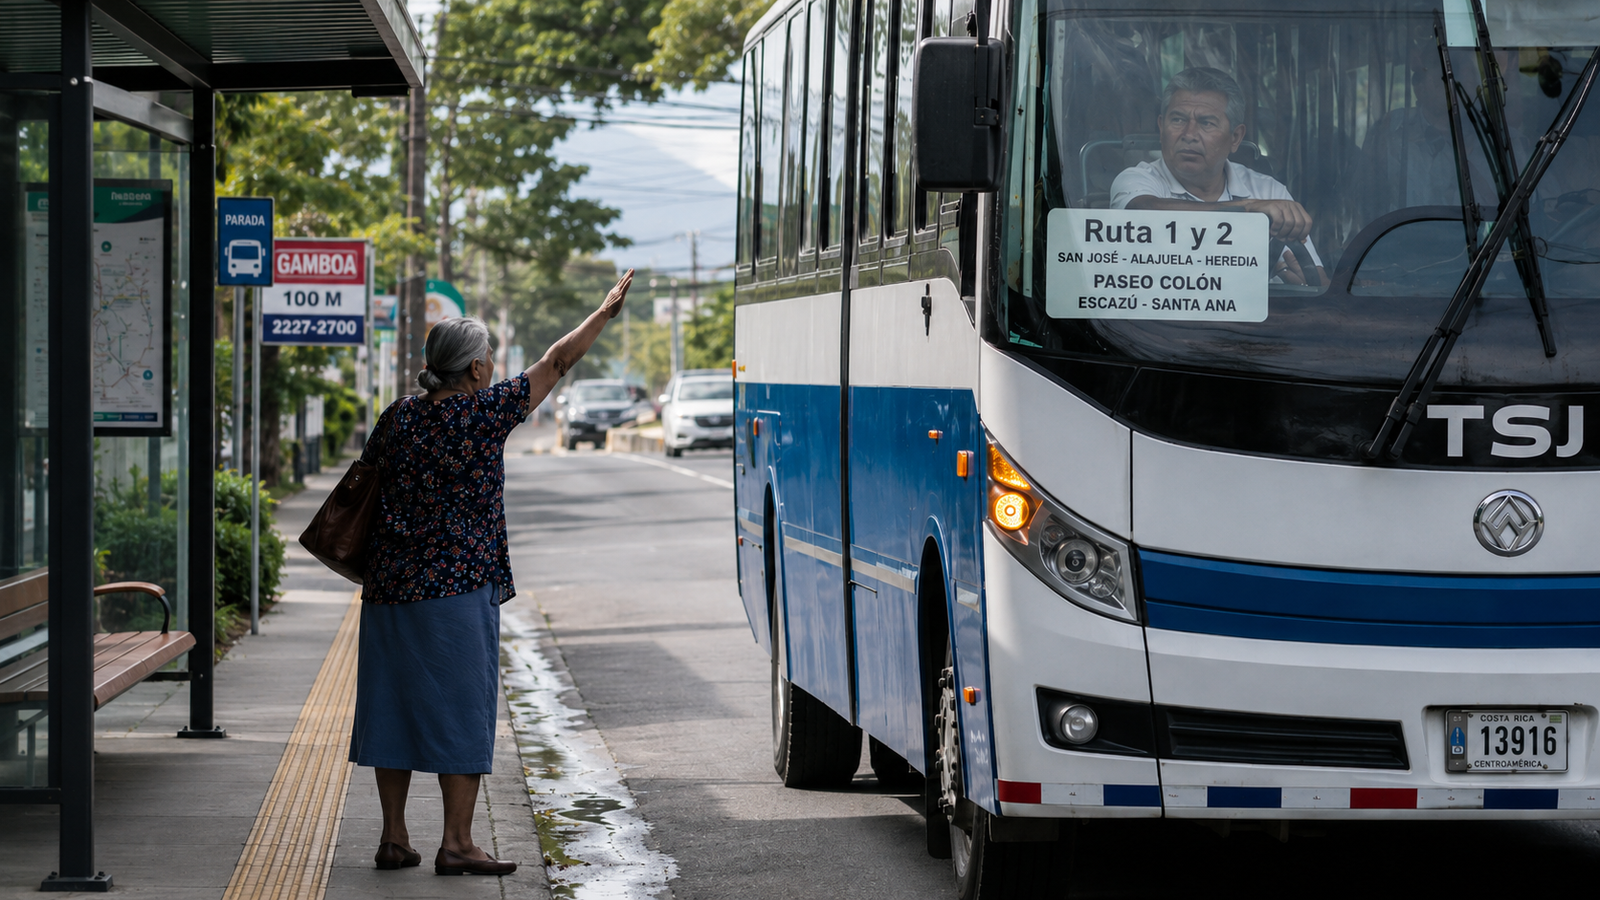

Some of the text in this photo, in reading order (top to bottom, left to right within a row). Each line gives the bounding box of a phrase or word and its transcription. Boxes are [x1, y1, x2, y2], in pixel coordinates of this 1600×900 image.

[225, 214, 265, 226] PARADA
[1085, 218, 1233, 251] Ruta 1 y 2
[277, 253, 357, 275] GAMBOA
[1058, 252, 1083, 263] SAN
[1087, 250, 1119, 264] JOSÉ
[1130, 253, 1193, 266] ALAJUELA
[1205, 255, 1258, 267] HEREDIA
[1094, 273, 1222, 291] PASEO COLÓN
[283, 290, 342, 307] 100 M
[1078, 294, 1137, 310] ESCAZÚ
[1152, 298, 1200, 311] SANTA
[1205, 299, 1237, 312] ANA
[272, 319, 357, 335] 2227-2700
[1427, 404, 1584, 458] TSJ
[1480, 714, 1535, 722] COSTA RICA
[1480, 725, 1557, 756] 13916
[1474, 759, 1542, 768] CENTROAMÉRICA
